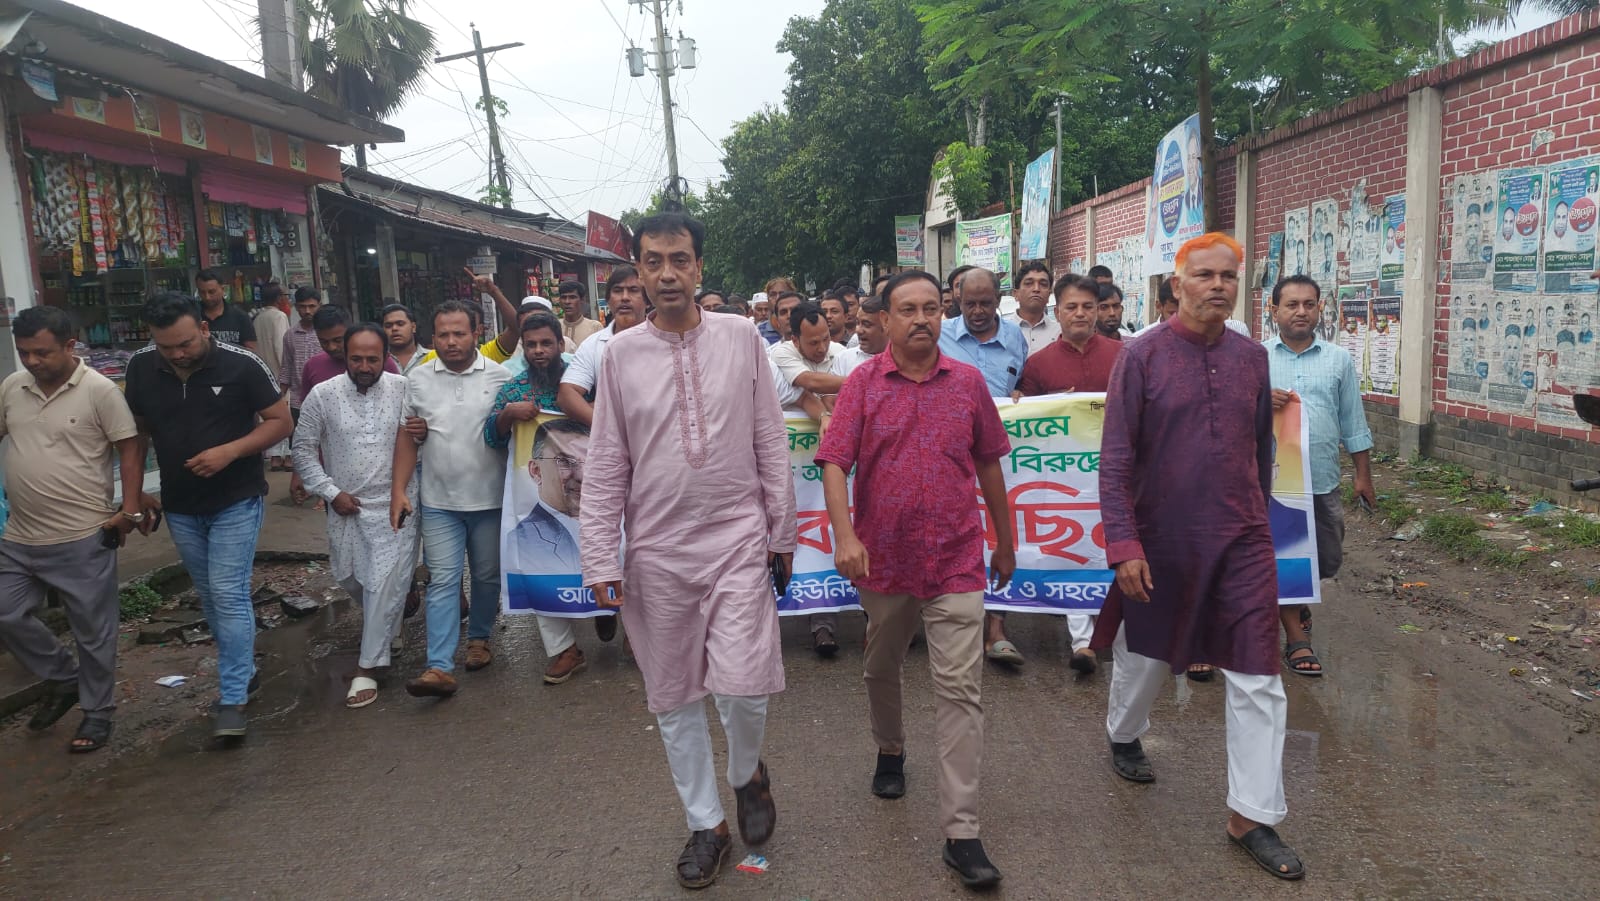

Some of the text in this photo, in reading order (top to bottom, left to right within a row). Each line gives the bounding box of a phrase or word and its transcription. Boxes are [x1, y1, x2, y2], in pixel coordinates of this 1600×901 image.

[1002, 415, 1071, 438] ধ্যমে
[790, 575, 857, 603] ইউনিয়
[1018, 581, 1037, 599] ও
